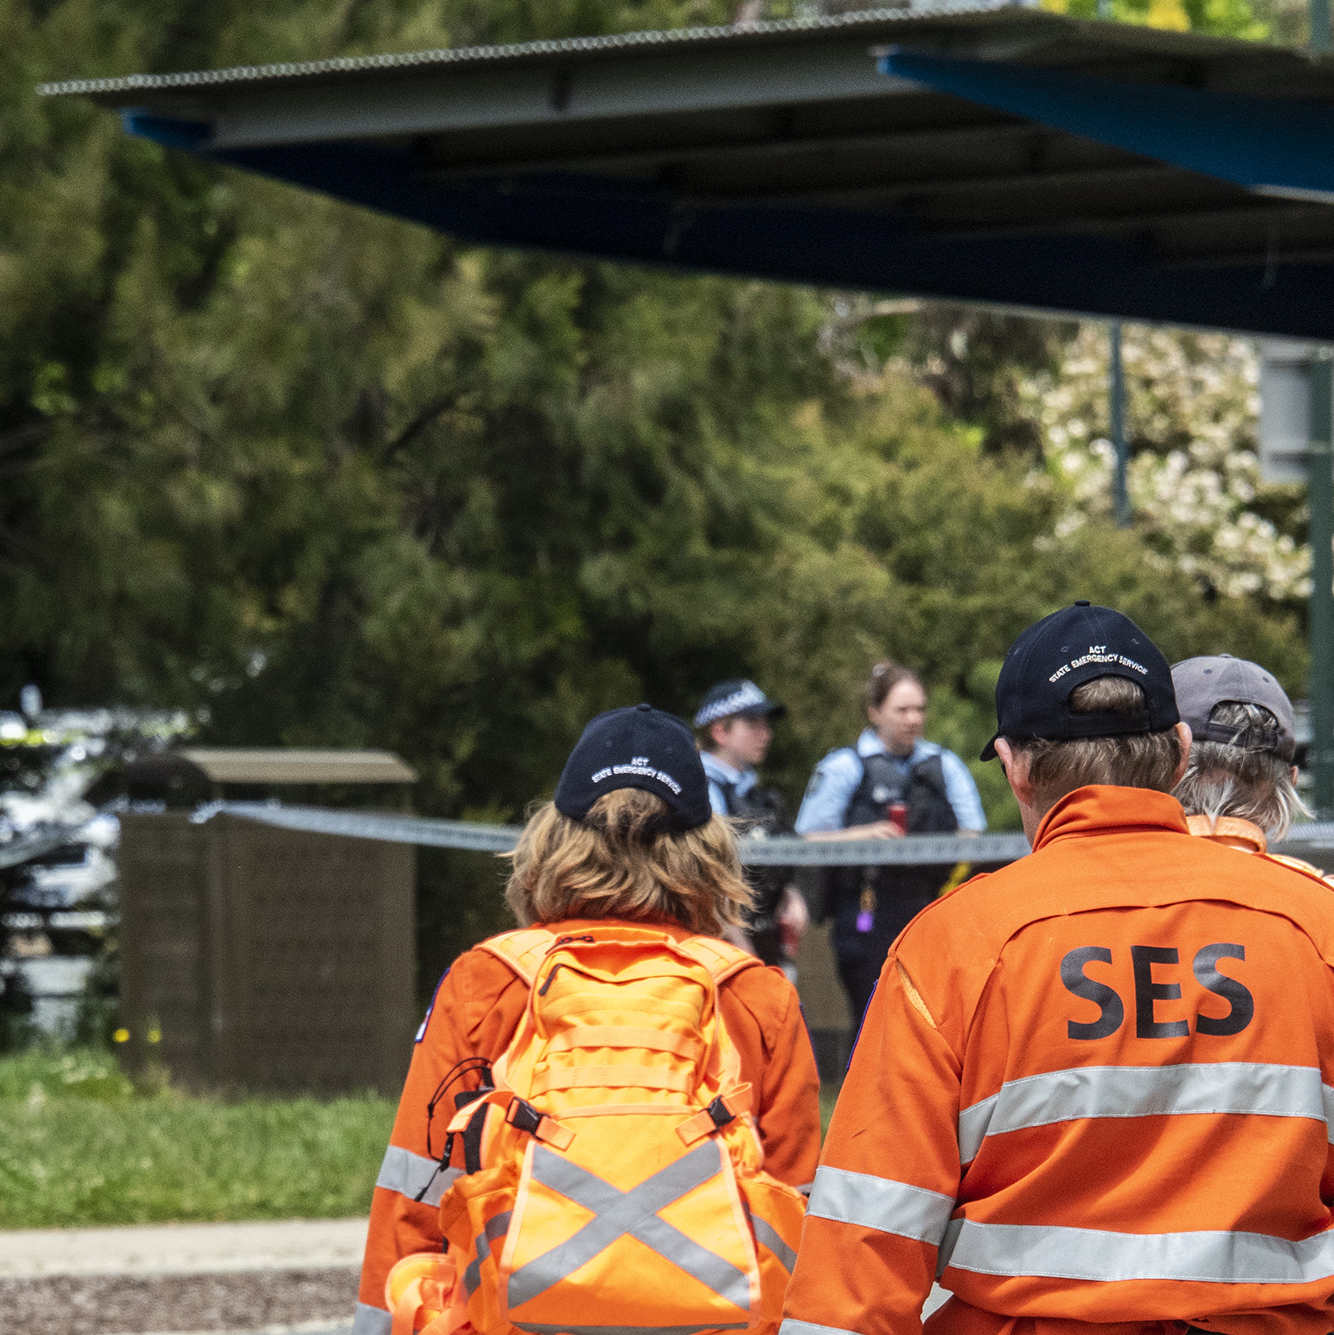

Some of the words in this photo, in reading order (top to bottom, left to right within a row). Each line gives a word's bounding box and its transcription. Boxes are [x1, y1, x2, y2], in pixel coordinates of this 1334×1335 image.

[1089, 645, 1107, 654] ACT
[1049, 664, 1071, 683] STATE
[1070, 653, 1119, 669] EMERGENCY
[1118, 655, 1148, 675] SERVICE
[631, 756, 650, 766] ACT
[591, 766, 613, 783] STATE
[612, 763, 658, 778] EMERGENCY
[656, 770, 682, 796] SERVICE
[1059, 942, 1255, 1041] SES
